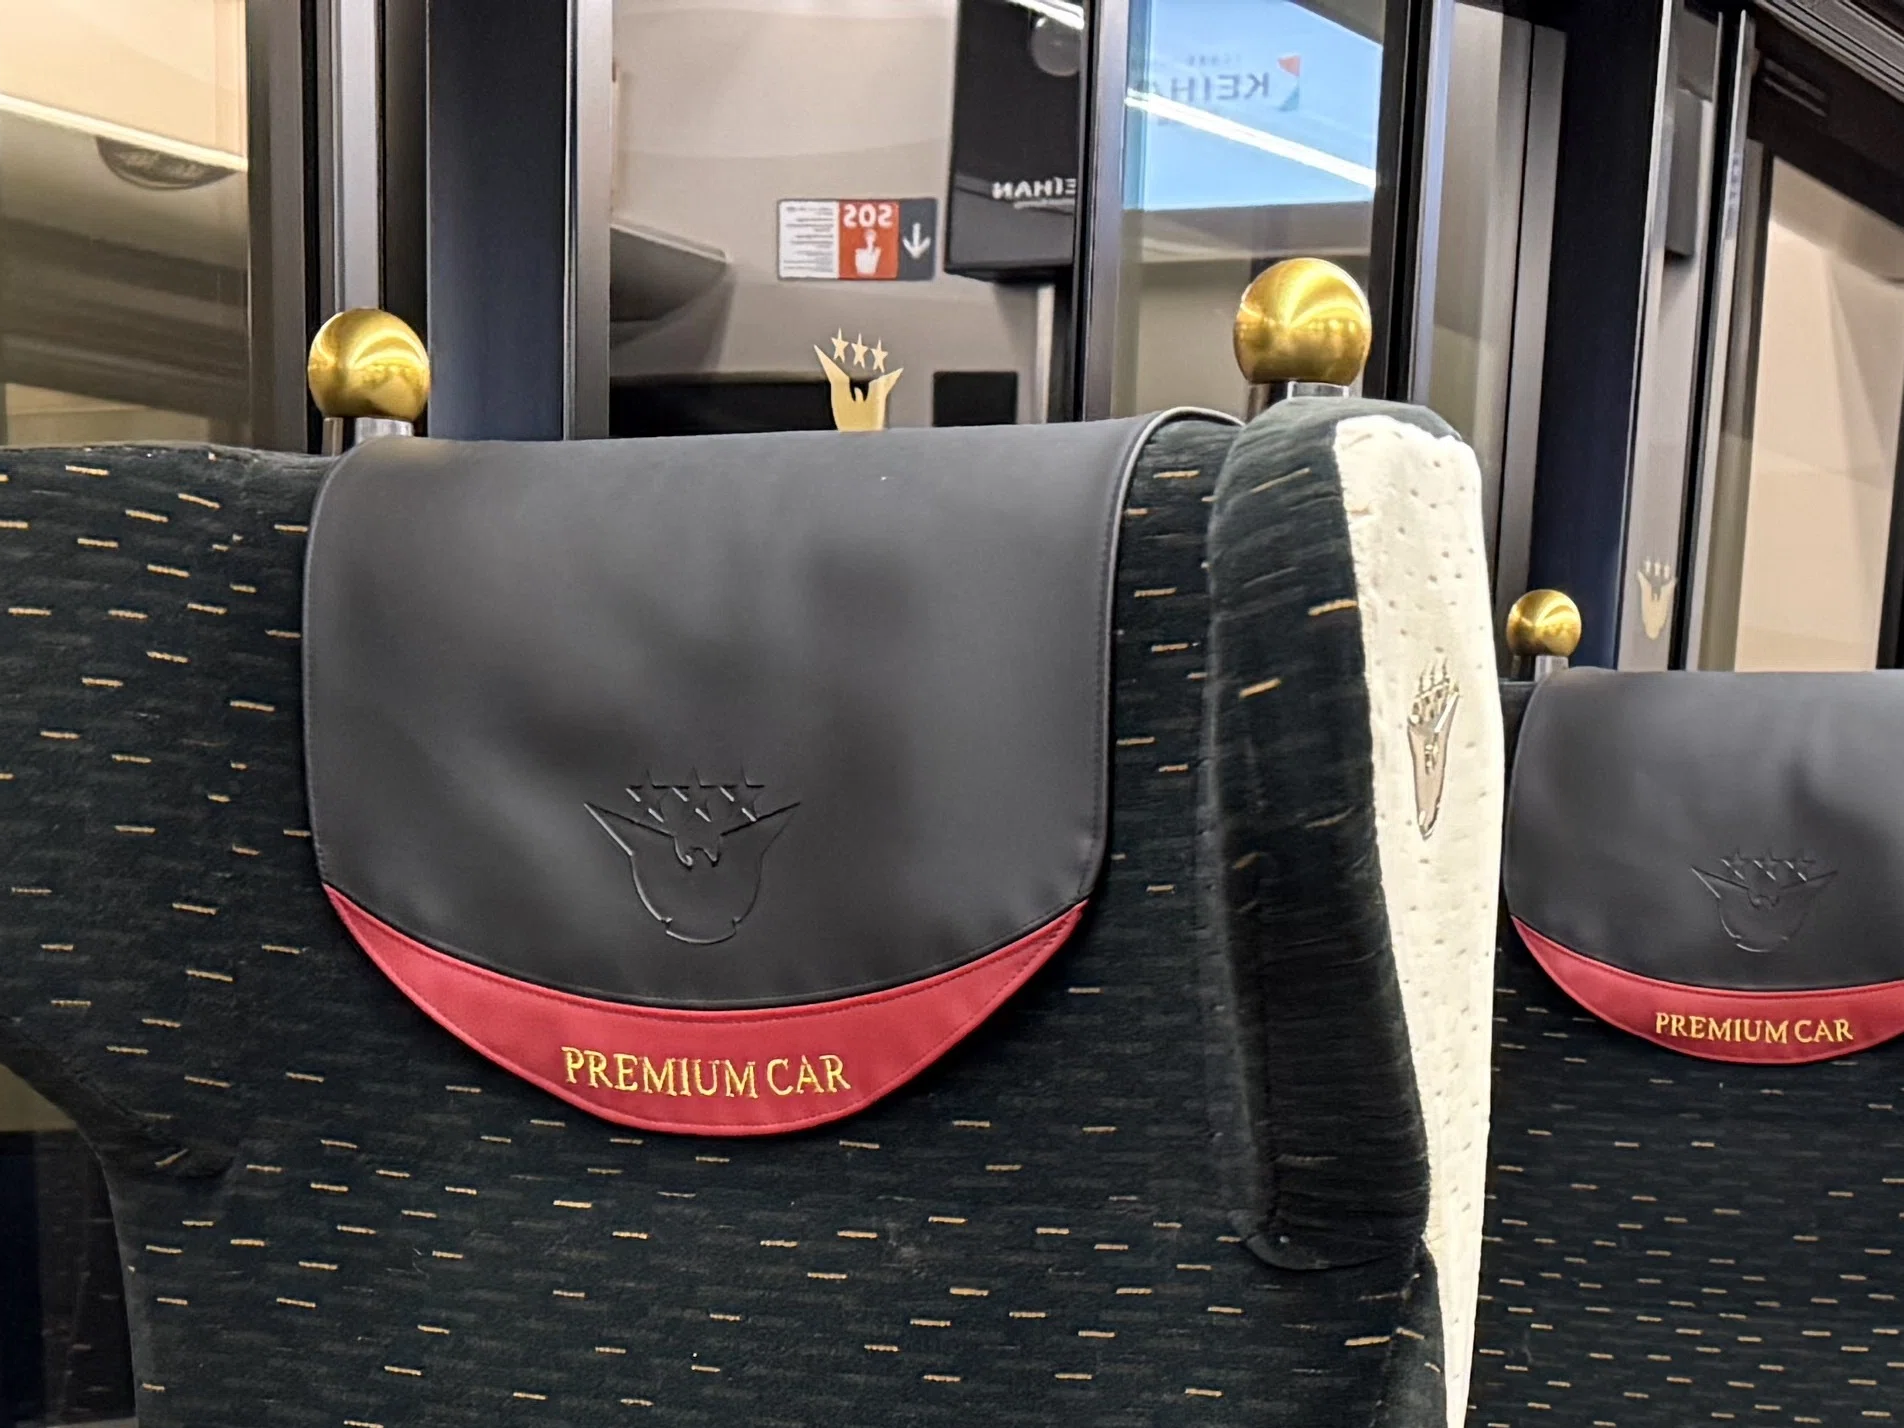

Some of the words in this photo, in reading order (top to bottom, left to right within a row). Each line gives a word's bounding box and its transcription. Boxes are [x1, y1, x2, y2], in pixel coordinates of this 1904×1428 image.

[1655, 1011, 1789, 1044] PREMIUM
[1794, 1018, 1854, 1043] CAR
[561, 1045, 759, 1099] PREMIUM
[766, 1054, 852, 1096] CAR
